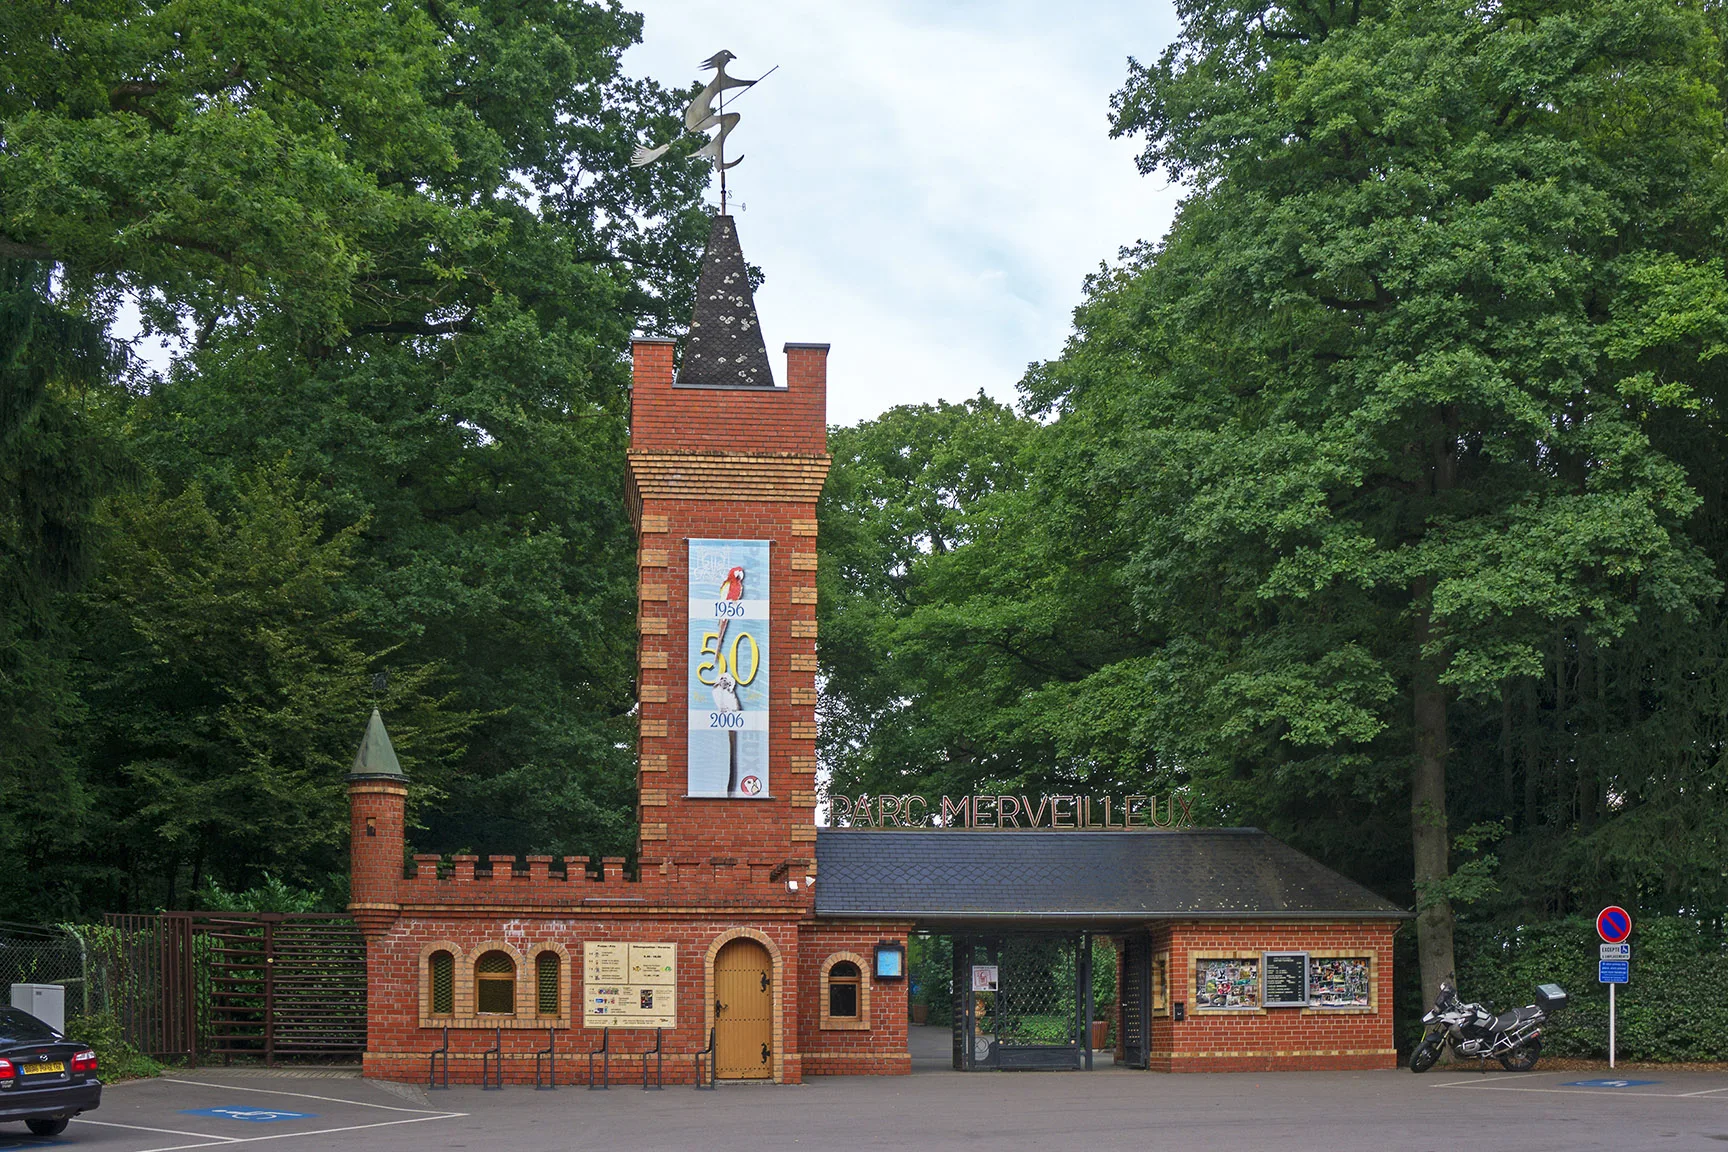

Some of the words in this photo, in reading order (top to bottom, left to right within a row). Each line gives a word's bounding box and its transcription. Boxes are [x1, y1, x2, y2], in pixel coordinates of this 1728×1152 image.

[715, 602, 745, 617] 1956
[697, 632, 759, 685] 50
[710, 712, 744, 728] 2006
[829, 794, 927, 828] PARC
[942, 794, 1197, 828] MERVEILLEUX
